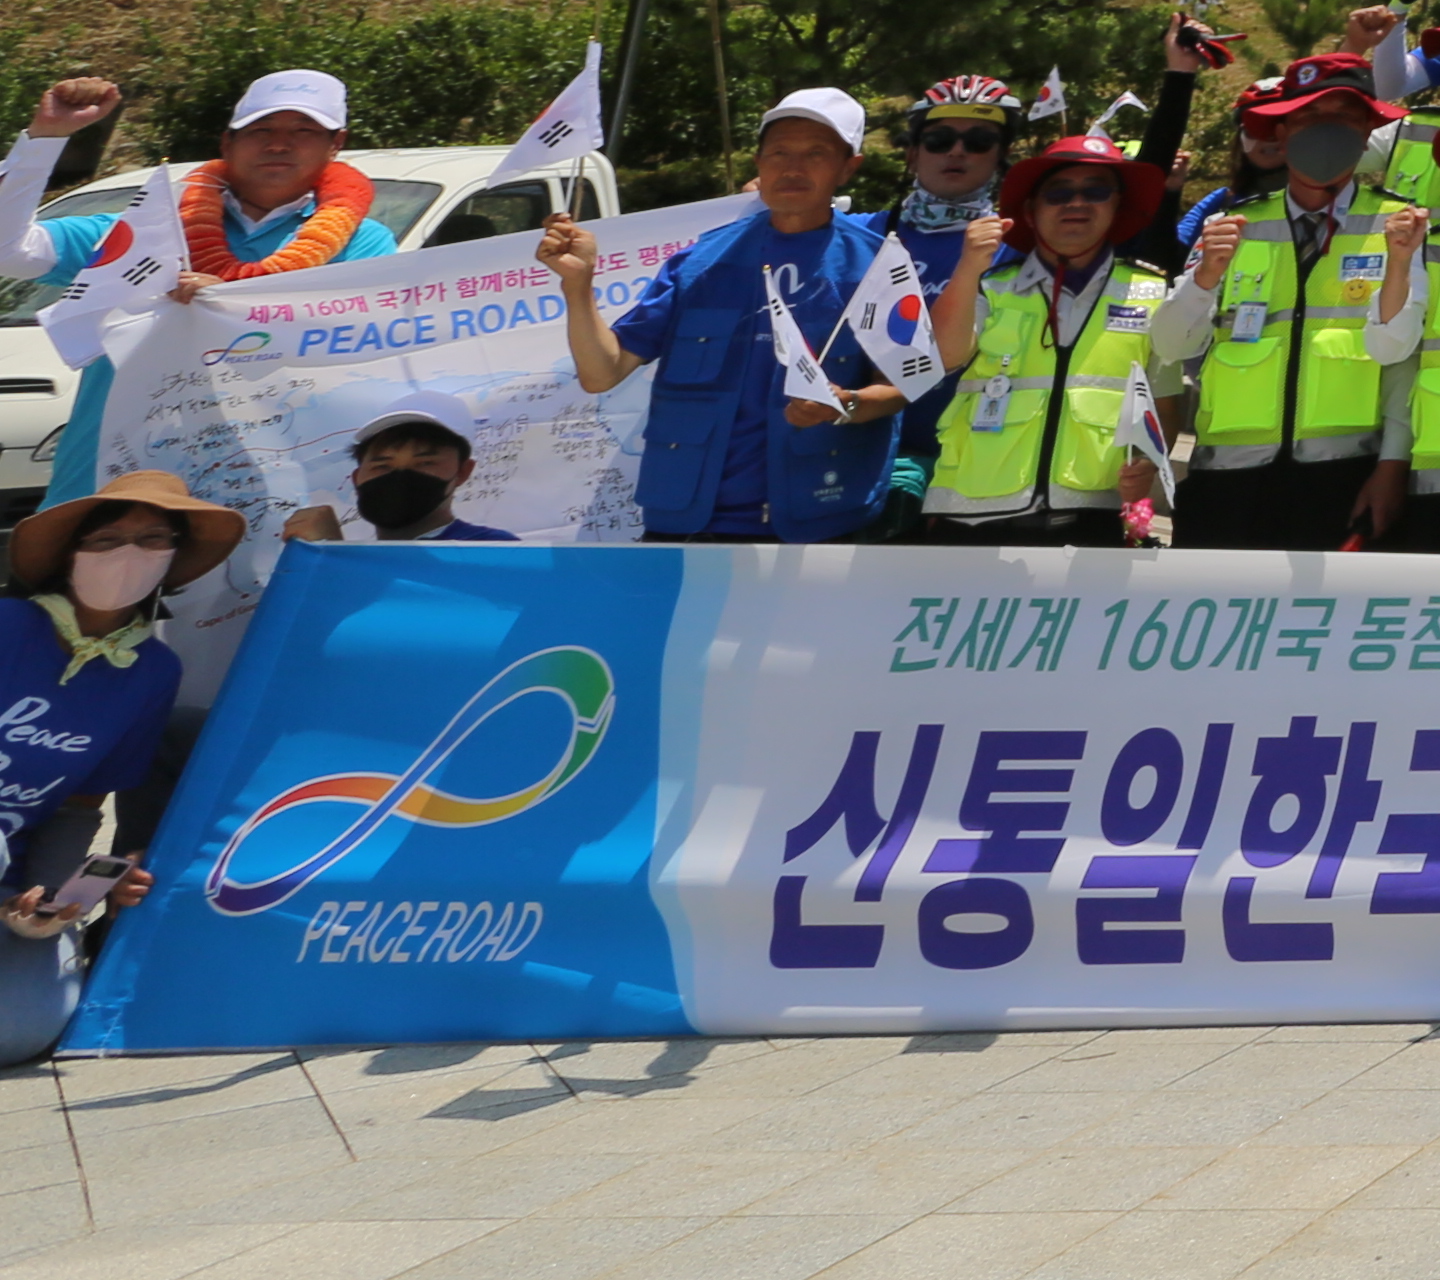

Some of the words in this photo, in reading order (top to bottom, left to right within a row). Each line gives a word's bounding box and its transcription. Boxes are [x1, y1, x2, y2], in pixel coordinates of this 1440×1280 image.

[245, 303, 294, 324] 세계
[302, 295, 370, 319] 160개
[376, 281, 448, 310] 국가가
[455, 265, 551, 299] 함께하는
[296, 313, 438, 358] PEACE
[450, 294, 566, 340] ROAD
[889, 596, 1080, 673] 전세계
[1097, 596, 1337, 672] 160개국
[0, 696, 92, 753] Peace
[295, 901, 428, 964] PEACE
[415, 901, 545, 963] ROAD
